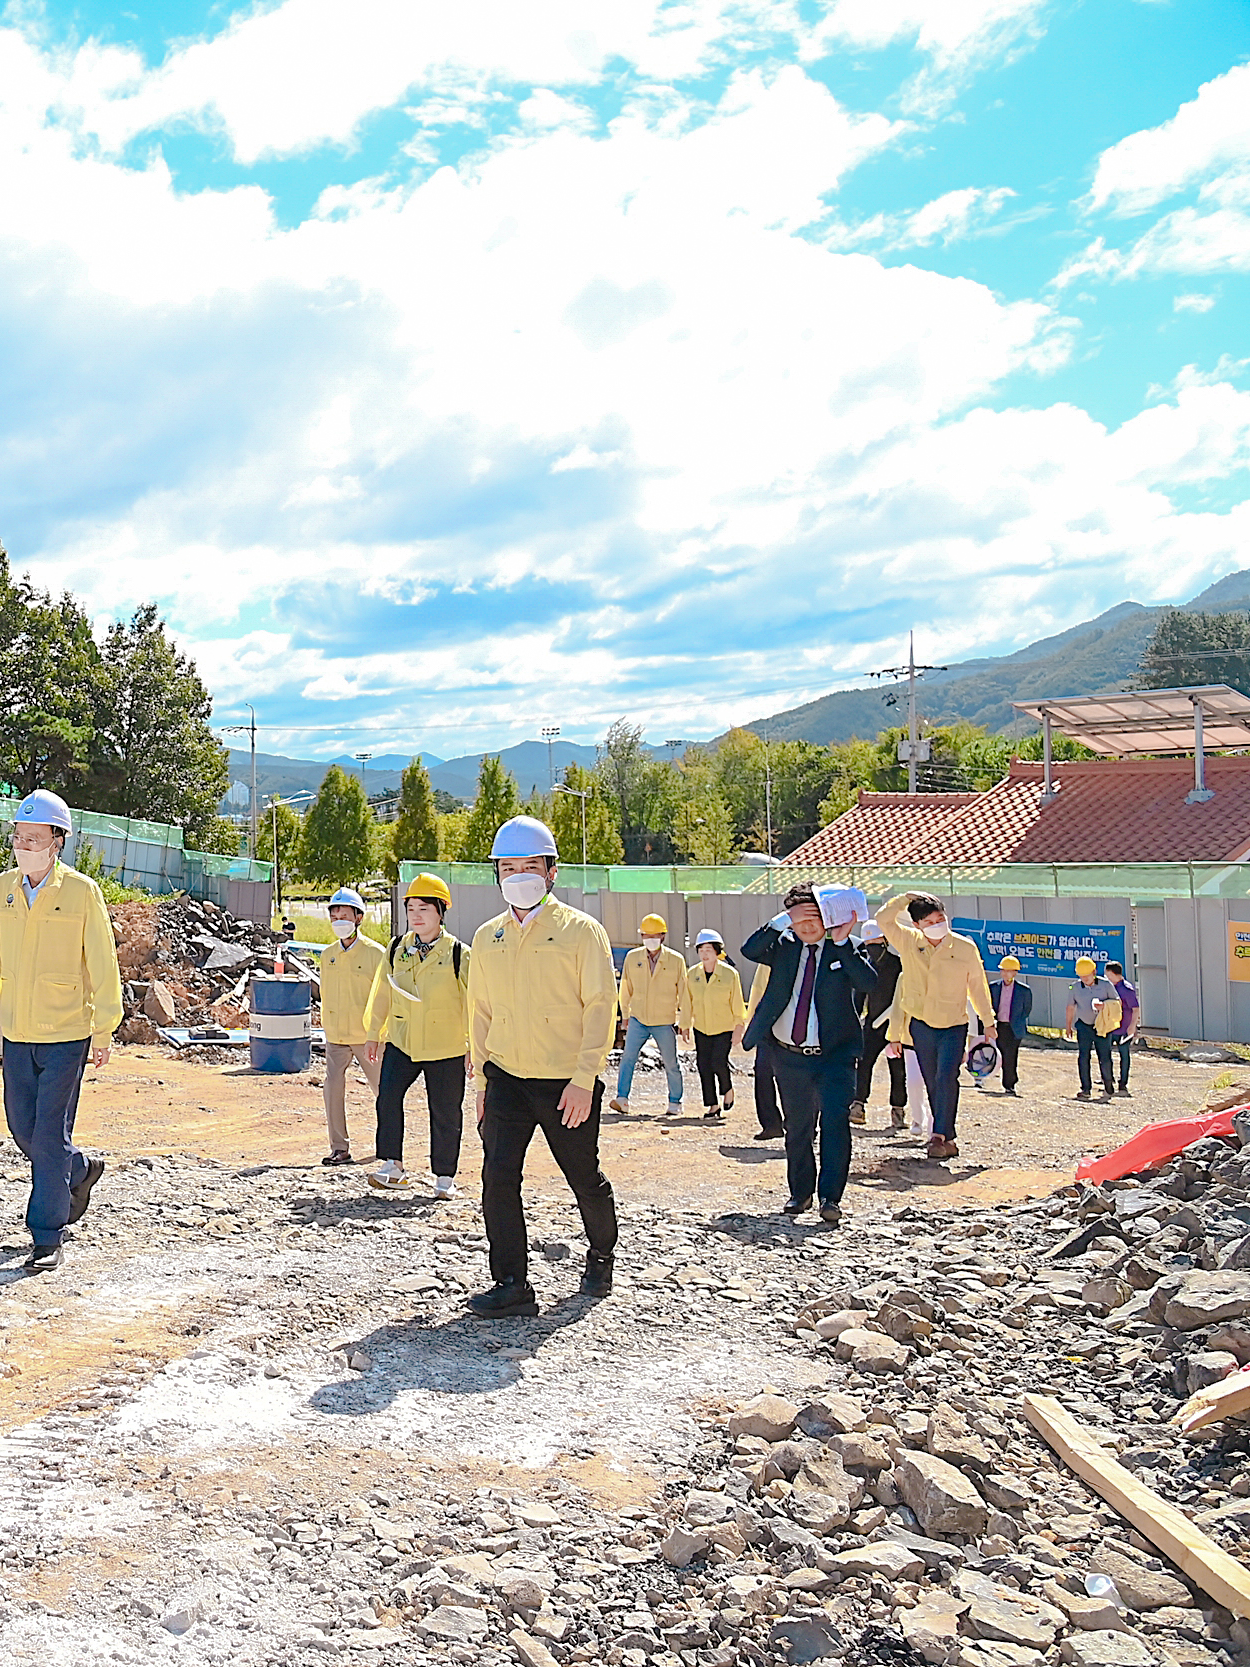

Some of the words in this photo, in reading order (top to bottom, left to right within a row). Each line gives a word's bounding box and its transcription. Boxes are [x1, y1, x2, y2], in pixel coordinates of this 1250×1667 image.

[987, 932, 1011, 943] 추락은
[1014, 934, 1057, 946] 브레이크가
[1059, 936, 1097, 949] 없습니다.
[1010, 946, 1034, 957] 오늘도
[1037, 948, 1061, 959] 안전을
